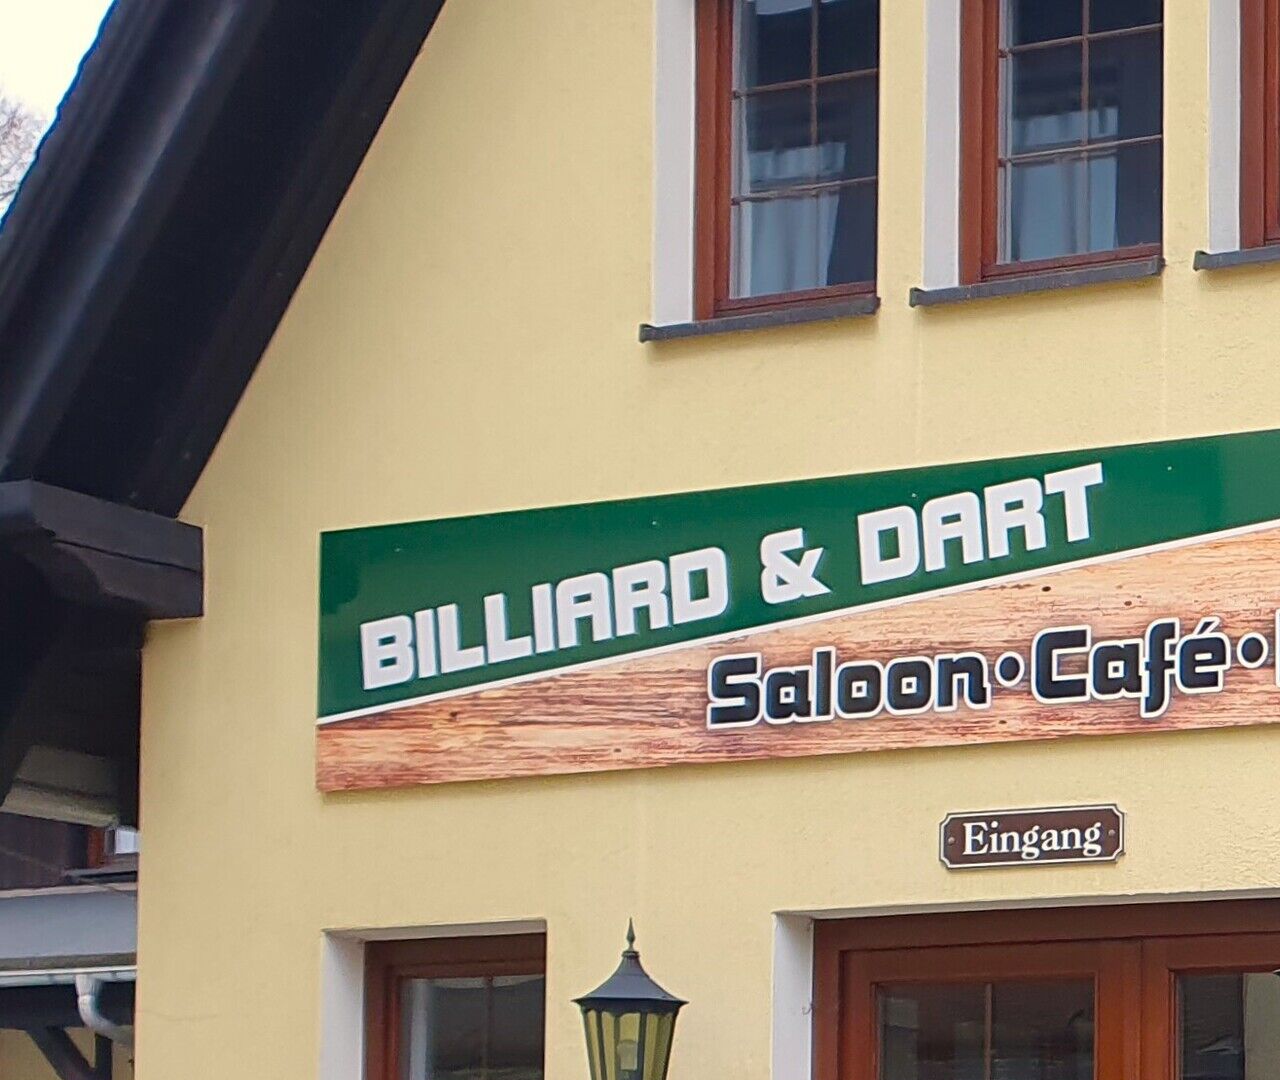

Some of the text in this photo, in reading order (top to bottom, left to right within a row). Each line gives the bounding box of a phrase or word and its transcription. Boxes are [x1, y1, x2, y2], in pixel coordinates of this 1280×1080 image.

[360, 463, 1103, 690] BILLIARD & DART
[962, 820, 1102, 860] Eingang
